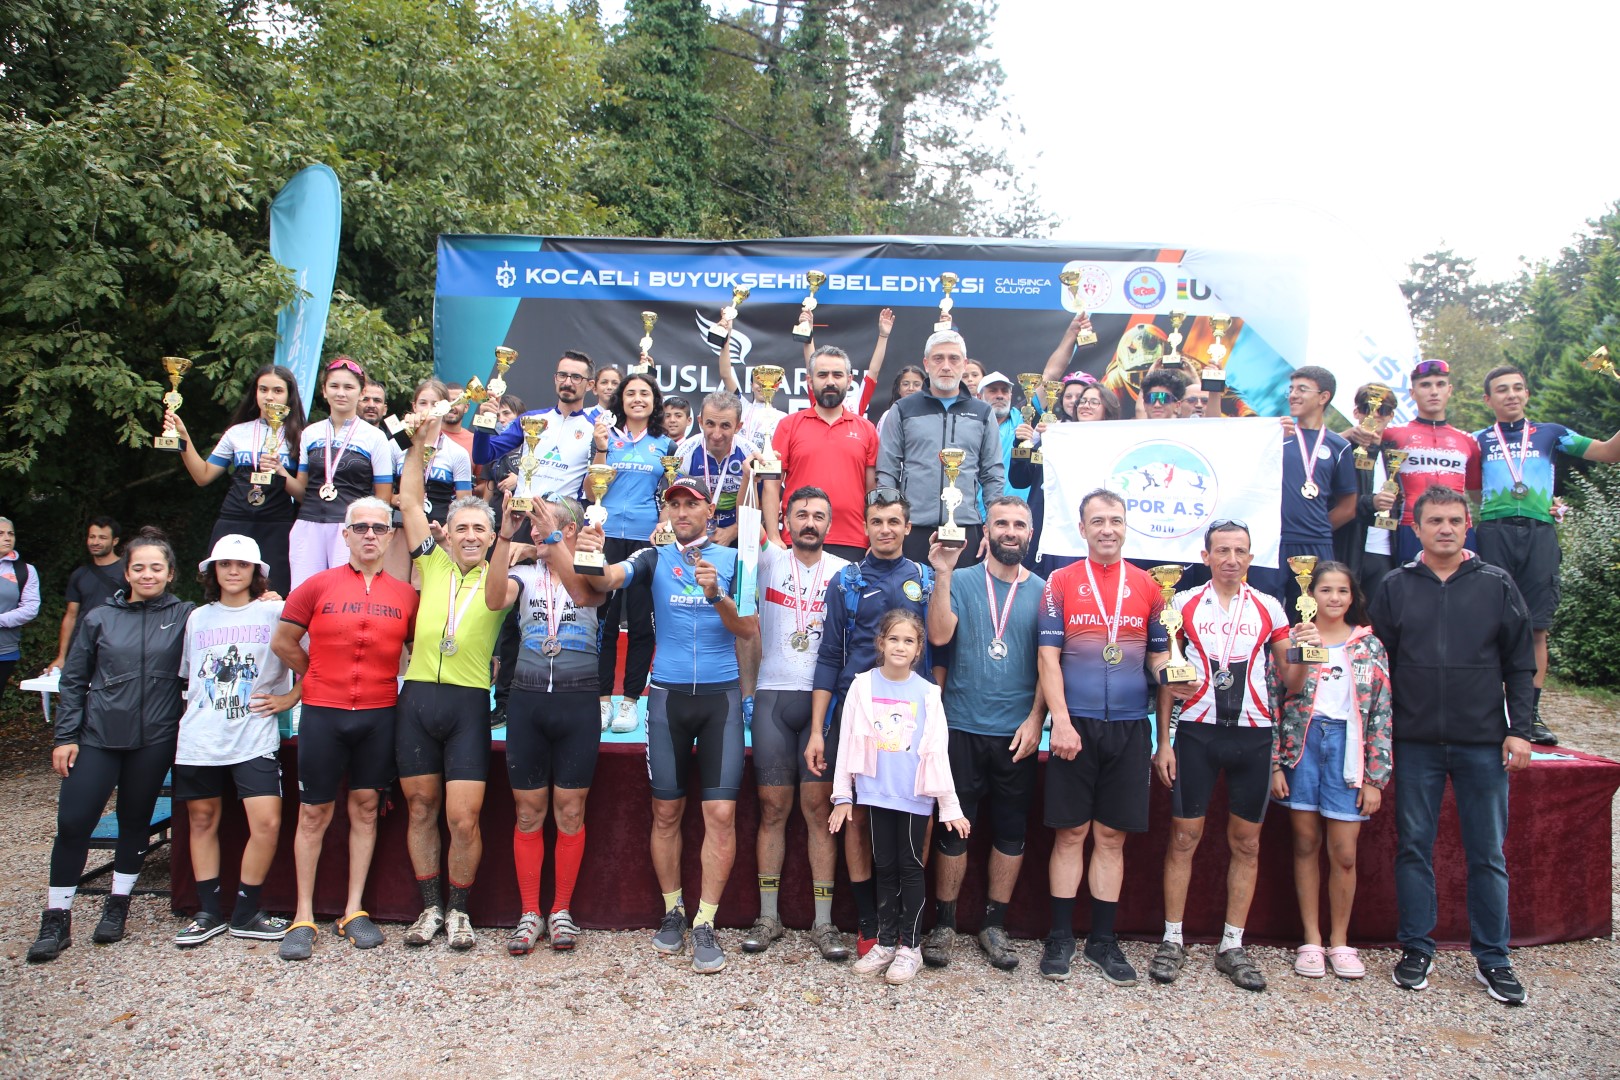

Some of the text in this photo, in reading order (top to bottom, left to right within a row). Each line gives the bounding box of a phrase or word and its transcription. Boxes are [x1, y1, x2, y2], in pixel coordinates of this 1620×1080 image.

[828, 274, 984, 294] BELEDİYSİ
[994, 286, 1041, 295] OLUYOR
[1408, 454, 1462, 469] SİNOP
[1126, 498, 1165, 514] POR
[195, 624, 271, 651] RAMONES
